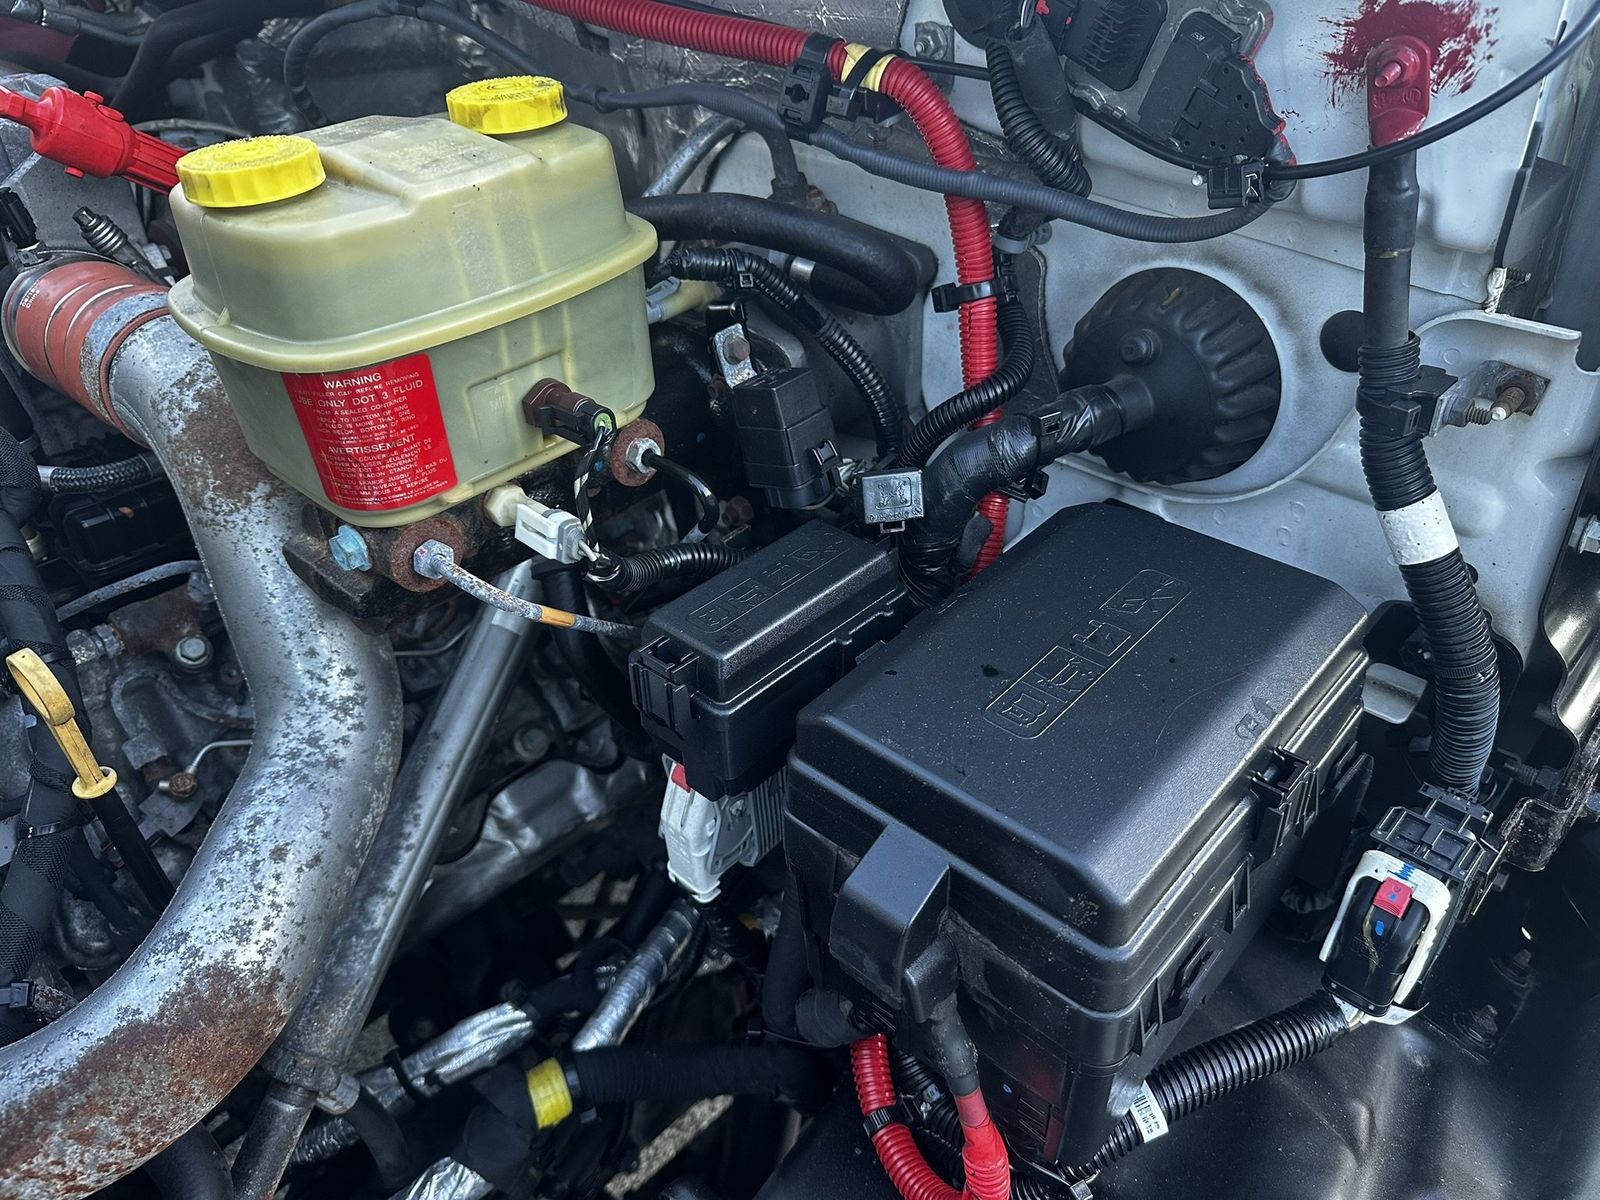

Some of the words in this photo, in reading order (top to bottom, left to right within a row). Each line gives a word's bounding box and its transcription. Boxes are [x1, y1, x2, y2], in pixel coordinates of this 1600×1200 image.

[323, 372, 382, 389] WARNING
[355, 383, 384, 394] BEFORE
[385, 371, 420, 387] REMOVING
[317, 398, 346, 408] ONLY
[352, 393, 376, 406] DOT
[381, 391, 389, 400] 3
[392, 379, 424, 396] FLUID
[340, 406, 368, 416] SEALED
[370, 395, 408, 411] CONTAINER
[352, 412, 381, 423] BOTTOM
[382, 409, 392, 417] OF
[394, 403, 409, 413] RING
[355, 420, 375, 428] MORE
[378, 415, 396, 424] THAN
[398, 409, 411, 418] ONE
[359, 423, 388, 434] BOTTOM
[401, 413, 416, 423] RING
[328, 433, 416, 455] AVERTISSEMENT
[402, 441, 421, 453] AVANT
[423, 437, 433, 445] DE
[359, 466, 373, 474] DOT
[381, 455, 419, 471] PROVENANT
[385, 448, 422, 464] SEULEMENT
[388, 462, 419, 475] ETANCHE
[414, 467, 424, 475] AU
[425, 461, 437, 470] BAS
[373, 481, 398, 490] NIVEAU
[421, 467, 437, 478] PLUS
[373, 488, 392, 497] SOUS
